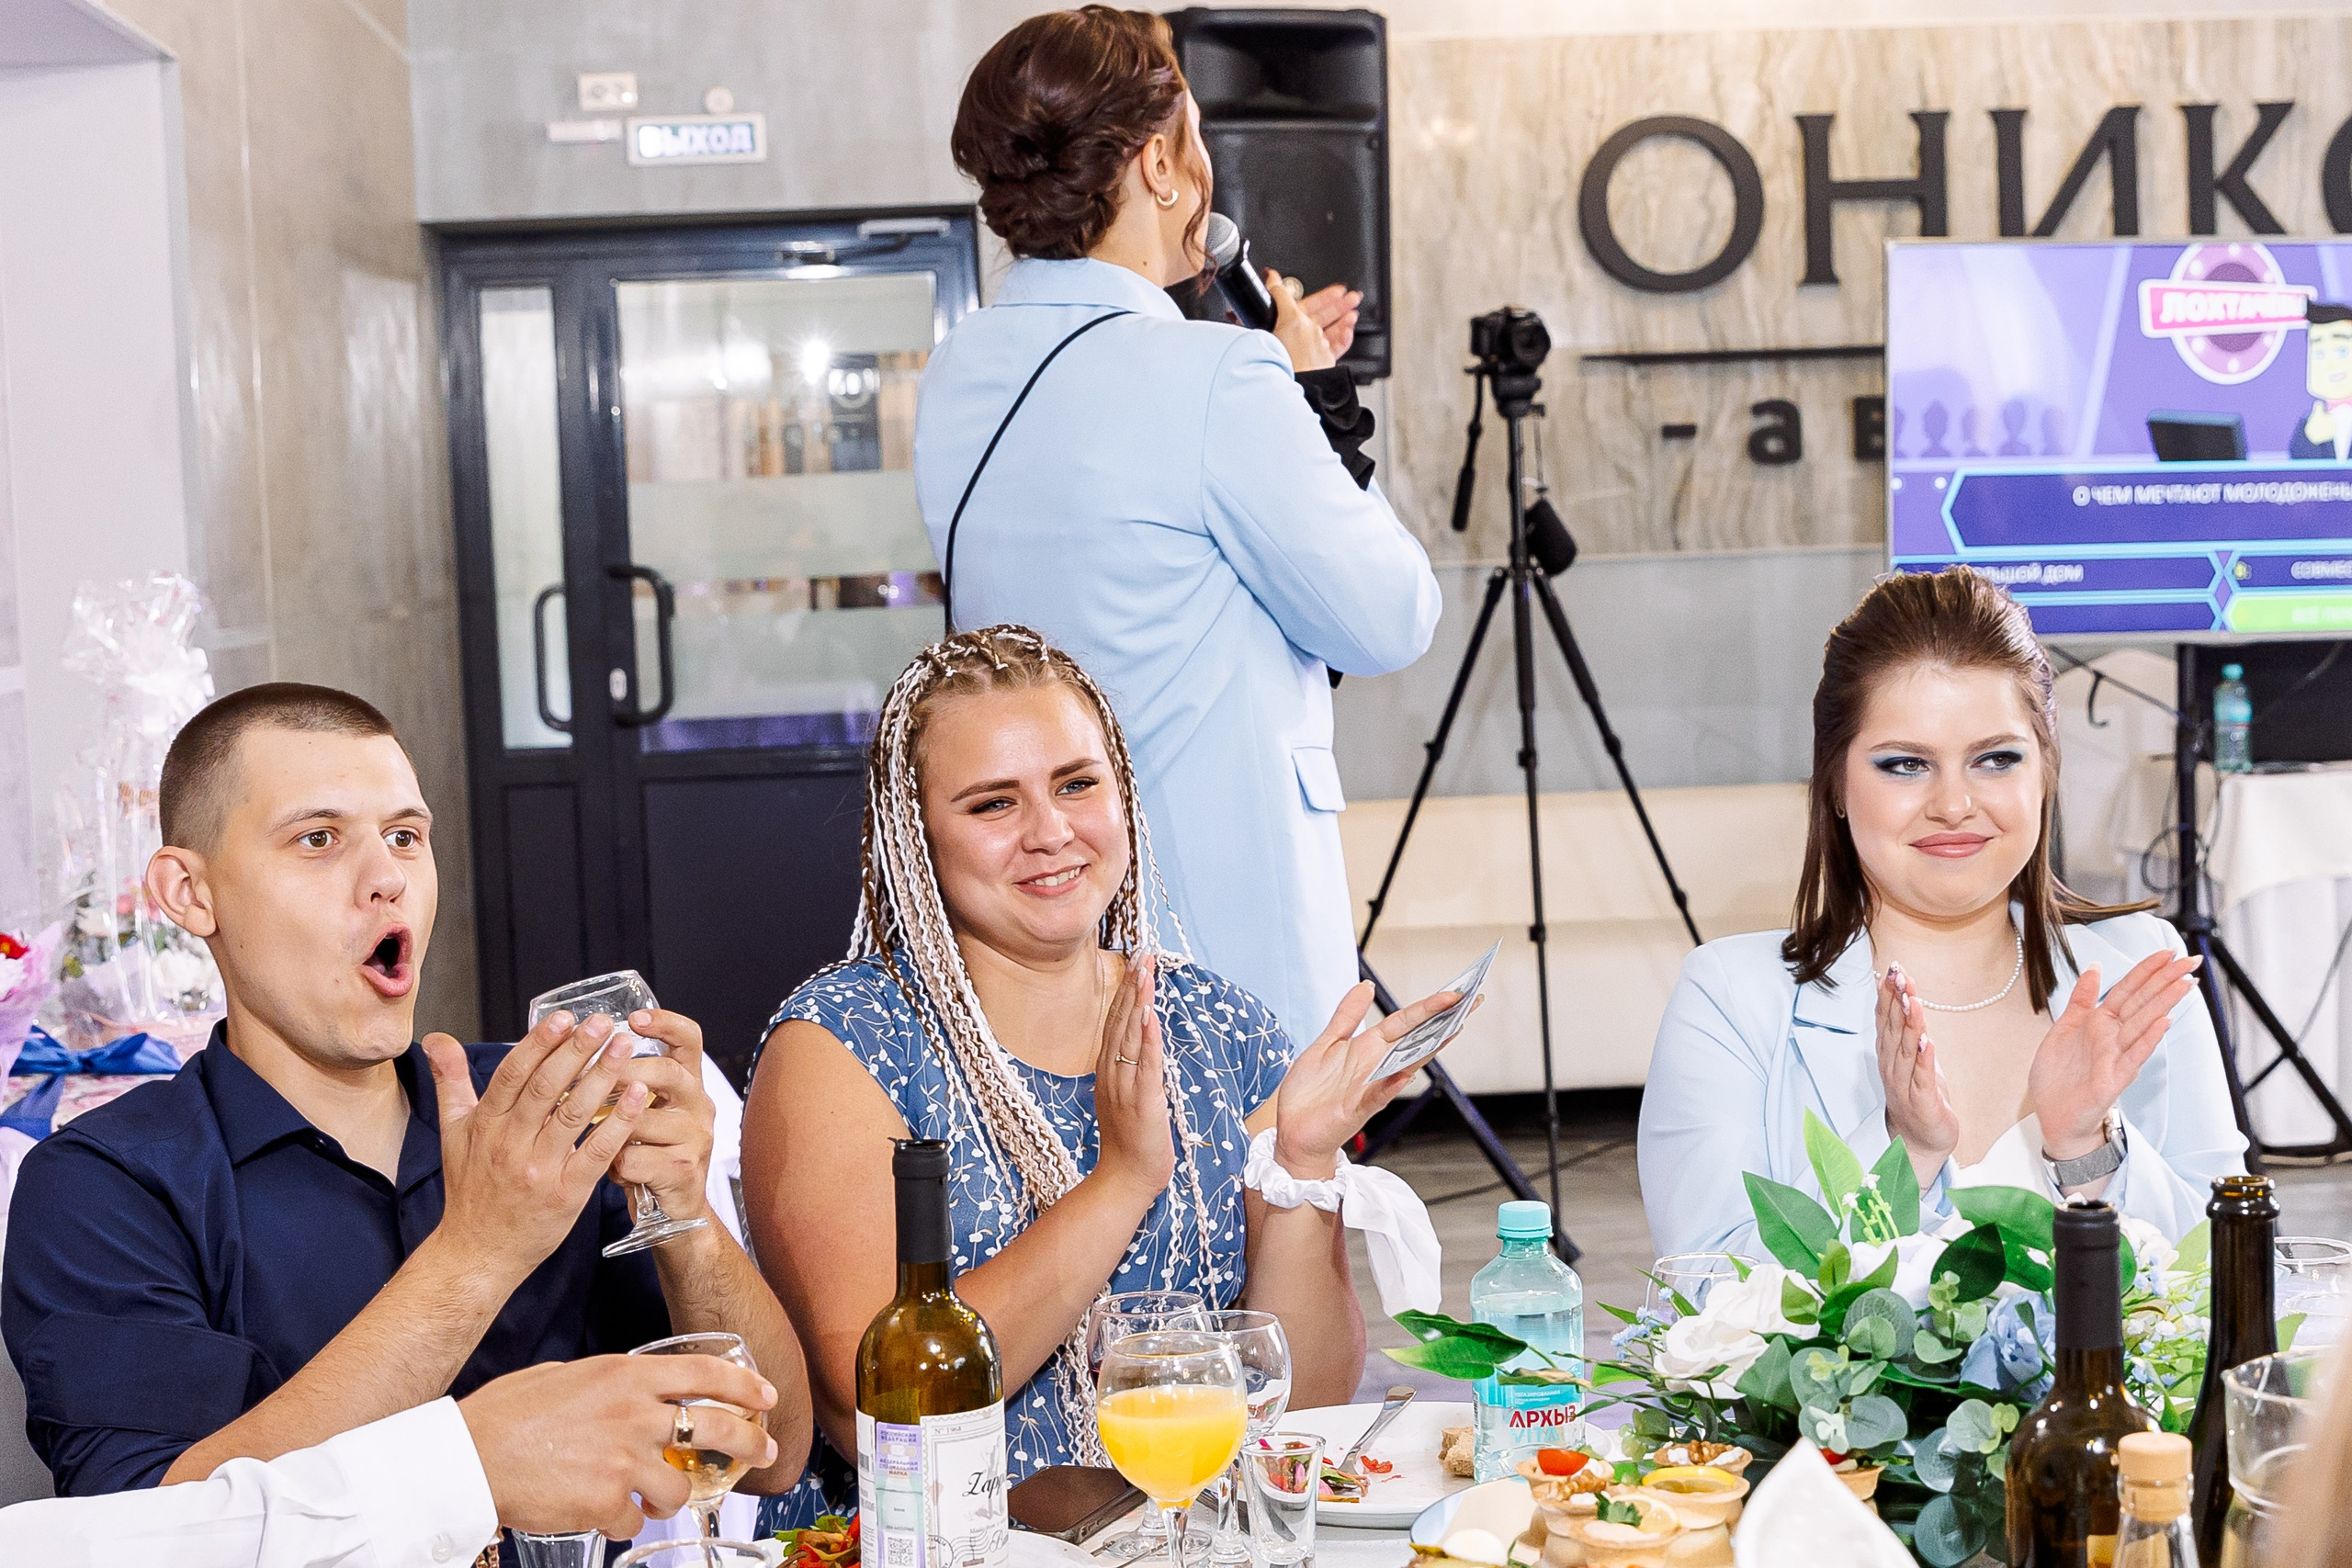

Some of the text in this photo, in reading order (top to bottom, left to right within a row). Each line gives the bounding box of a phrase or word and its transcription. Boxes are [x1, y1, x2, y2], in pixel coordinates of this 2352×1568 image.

[639, 121, 754, 158] ВЫХОД
[2072, 485, 2090, 506] О
[2090, 484, 2133, 505] ЧЕМ
[2133, 483, 2222, 504] МЕЧТАЮТ
[2041, 564, 2084, 586] ДОМ
[1510, 1404, 1577, 1428] АРХЫЗ
[1510, 1426, 1560, 1443] VITA
